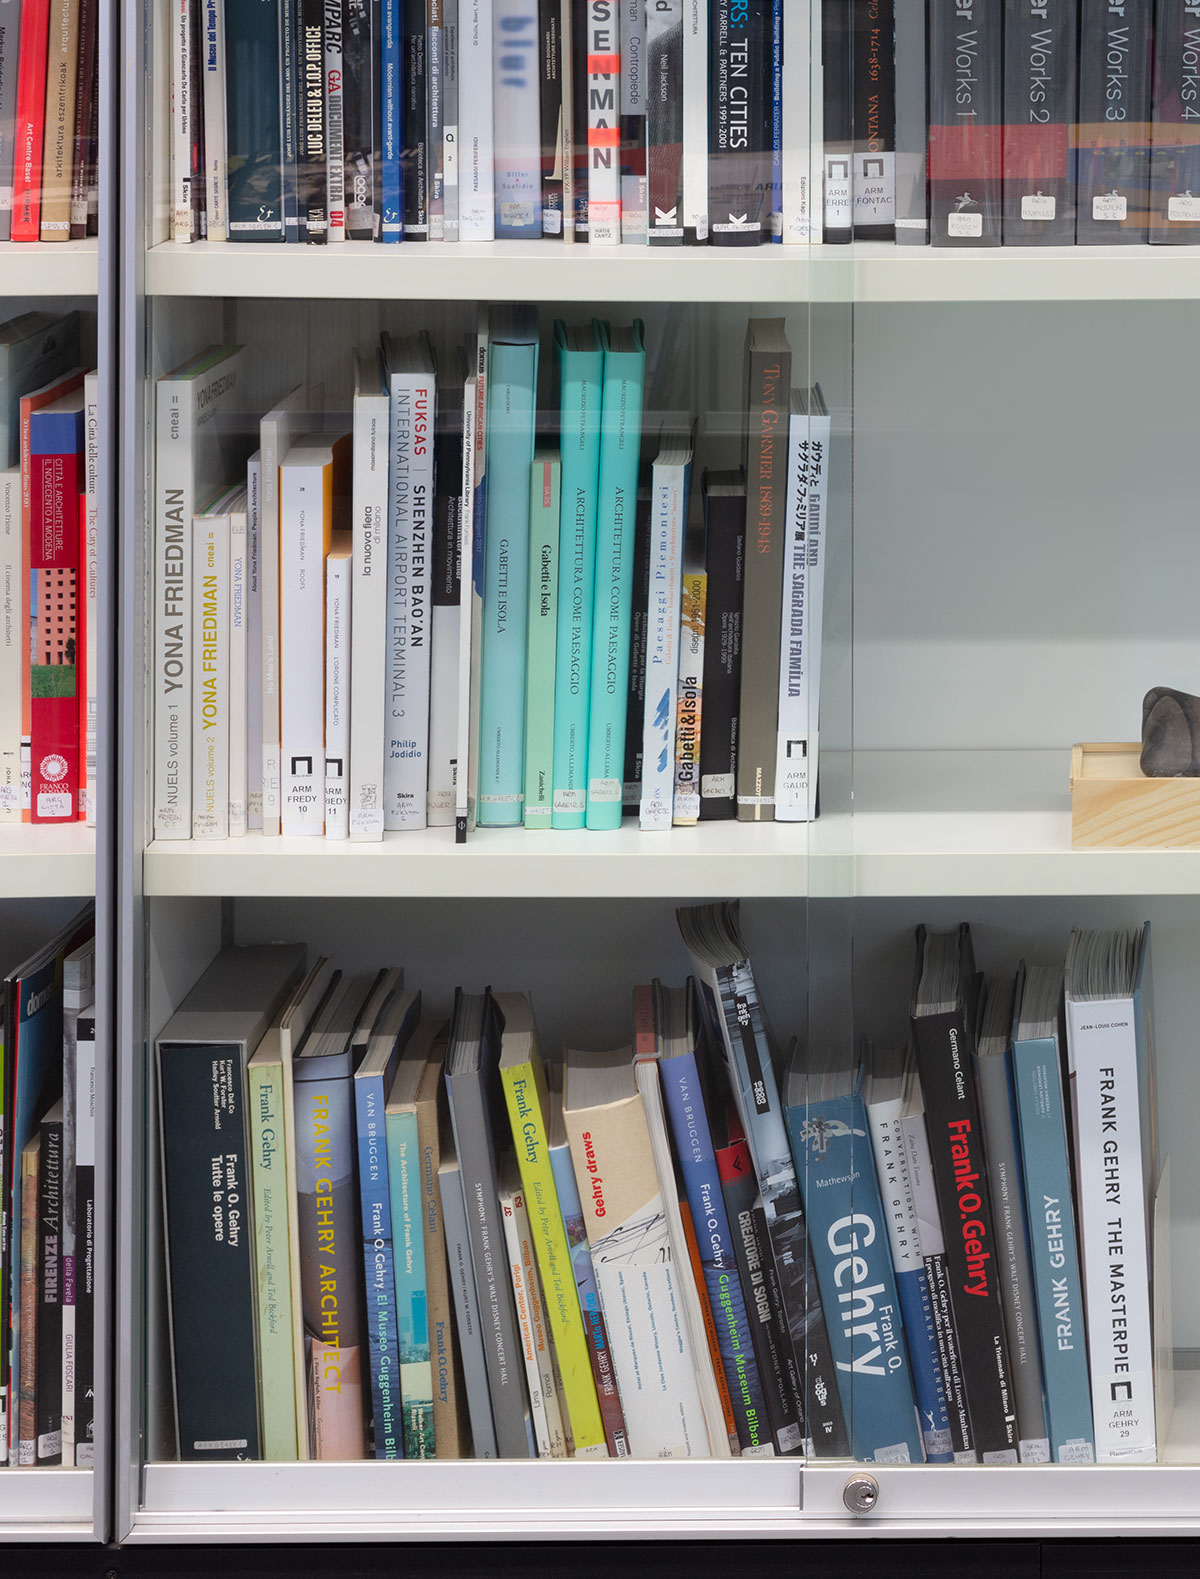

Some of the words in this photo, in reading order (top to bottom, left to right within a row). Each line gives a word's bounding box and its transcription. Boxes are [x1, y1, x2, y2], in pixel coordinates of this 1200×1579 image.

[719, 8, 728, 46] FARRELL
[628, 36, 641, 104] Contropiede
[660, 53, 669, 69] Neil
[719, 47, 727, 55] &
[730, 37, 747, 76] TEN
[955, 30, 978, 104] Works
[1029, 28, 1052, 102] Works
[1106, 26, 1129, 100] Works
[328, 70, 341, 94] GA
[660, 71, 669, 102] Jackson
[718, 58, 729, 102] PARTNERS
[328, 95, 342, 160] DOCUMENT
[718, 105, 728, 148] 1991-2001
[729, 86, 747, 148] CITIES
[956, 108, 977, 116] 1
[1029, 109, 1050, 123] 2
[1105, 106, 1126, 120] 3
[1180, 105, 1200, 120] 4
[25, 136, 33, 161] Centre
[23, 162, 33, 184] Basel
[328, 165, 342, 202] EXTRA
[330, 211, 343, 227] 04
[761, 366, 780, 405] TONY
[88, 404, 97, 416] La
[88, 418, 97, 440] Città
[414, 389, 427, 455] FUKSAS
[88, 442, 98, 462] delle
[395, 387, 412, 527] INTERNATIONAL
[760, 409, 778, 480] GARNIER
[44, 467, 52, 516] NOVECENTO
[54, 458, 63, 481] CITTÀ
[87, 463, 98, 493] culture
[54, 489, 64, 551] ARCHITETTURE
[411, 485, 425, 577] SHENZHEN
[611, 486, 624, 582] ARCHITETTURA
[757, 485, 772, 553] 1869-1948
[44, 525, 55, 562] MODENA
[164, 489, 184, 616] FRIEDMAN
[541, 544, 551, 582] Gabetti
[792, 543, 808, 569] THE
[393, 533, 407, 607] AIRPORT
[202, 575, 217, 672] FRIEDMAN
[410, 585, 424, 646] BAO'AN
[540, 592, 551, 616] Isola
[609, 586, 620, 621] COME
[790, 573, 804, 636] SAGRADA
[163, 623, 183, 694] YONA
[392, 615, 406, 702] TERMINAL
[606, 626, 618, 694] PAESAGGIO
[786, 640, 803, 698] FAMÍLIA
[202, 677, 217, 730] YONA
[391, 709, 405, 717] 3
[391, 740, 416, 749] Philip
[678, 676, 700, 783] Gabetti&Isola
[948, 1028, 960, 1069] Germano
[954, 1070, 965, 1100] Celant
[1099, 1067, 1117, 1133] FRANK
[311, 1094, 331, 1168] FRANK
[582, 1131, 598, 1173] draws
[225, 1153, 238, 1190] Frank
[947, 1119, 979, 1191] Frank
[1103, 1140, 1120, 1204] GEHRY
[42, 1132, 59, 1232] Architettura
[227, 1193, 239, 1207] O.
[590, 1176, 606, 1217] Gehry
[227, 1209, 240, 1246] Gehry
[313, 1178, 336, 1254] GEHRY
[1043, 1194, 1065, 1268] GEHRY
[1107, 1217, 1123, 1256] THE
[44, 1235, 57, 1302] FIRENZE
[827, 1214, 886, 1375] Gehry
[1051, 1276, 1073, 1350] FRANK
[319, 1264, 343, 1394] ARCHITECT
[878, 1304, 898, 1352] Frank
[1109, 1263, 1129, 1373] MASTERPIE
[64, 1334, 73, 1358] GIULIA
[718, 1274, 741, 1350] Guggenheim
[734, 1353, 751, 1405] Museum
[745, 1409, 761, 1445] Bilbao
[887, 1355, 902, 1373] O.
[64, 1360, 73, 1392] FOSCARI
[1108, 1420, 1139, 1428] GEHRY
[1113, 1410, 1133, 1418] ARM
